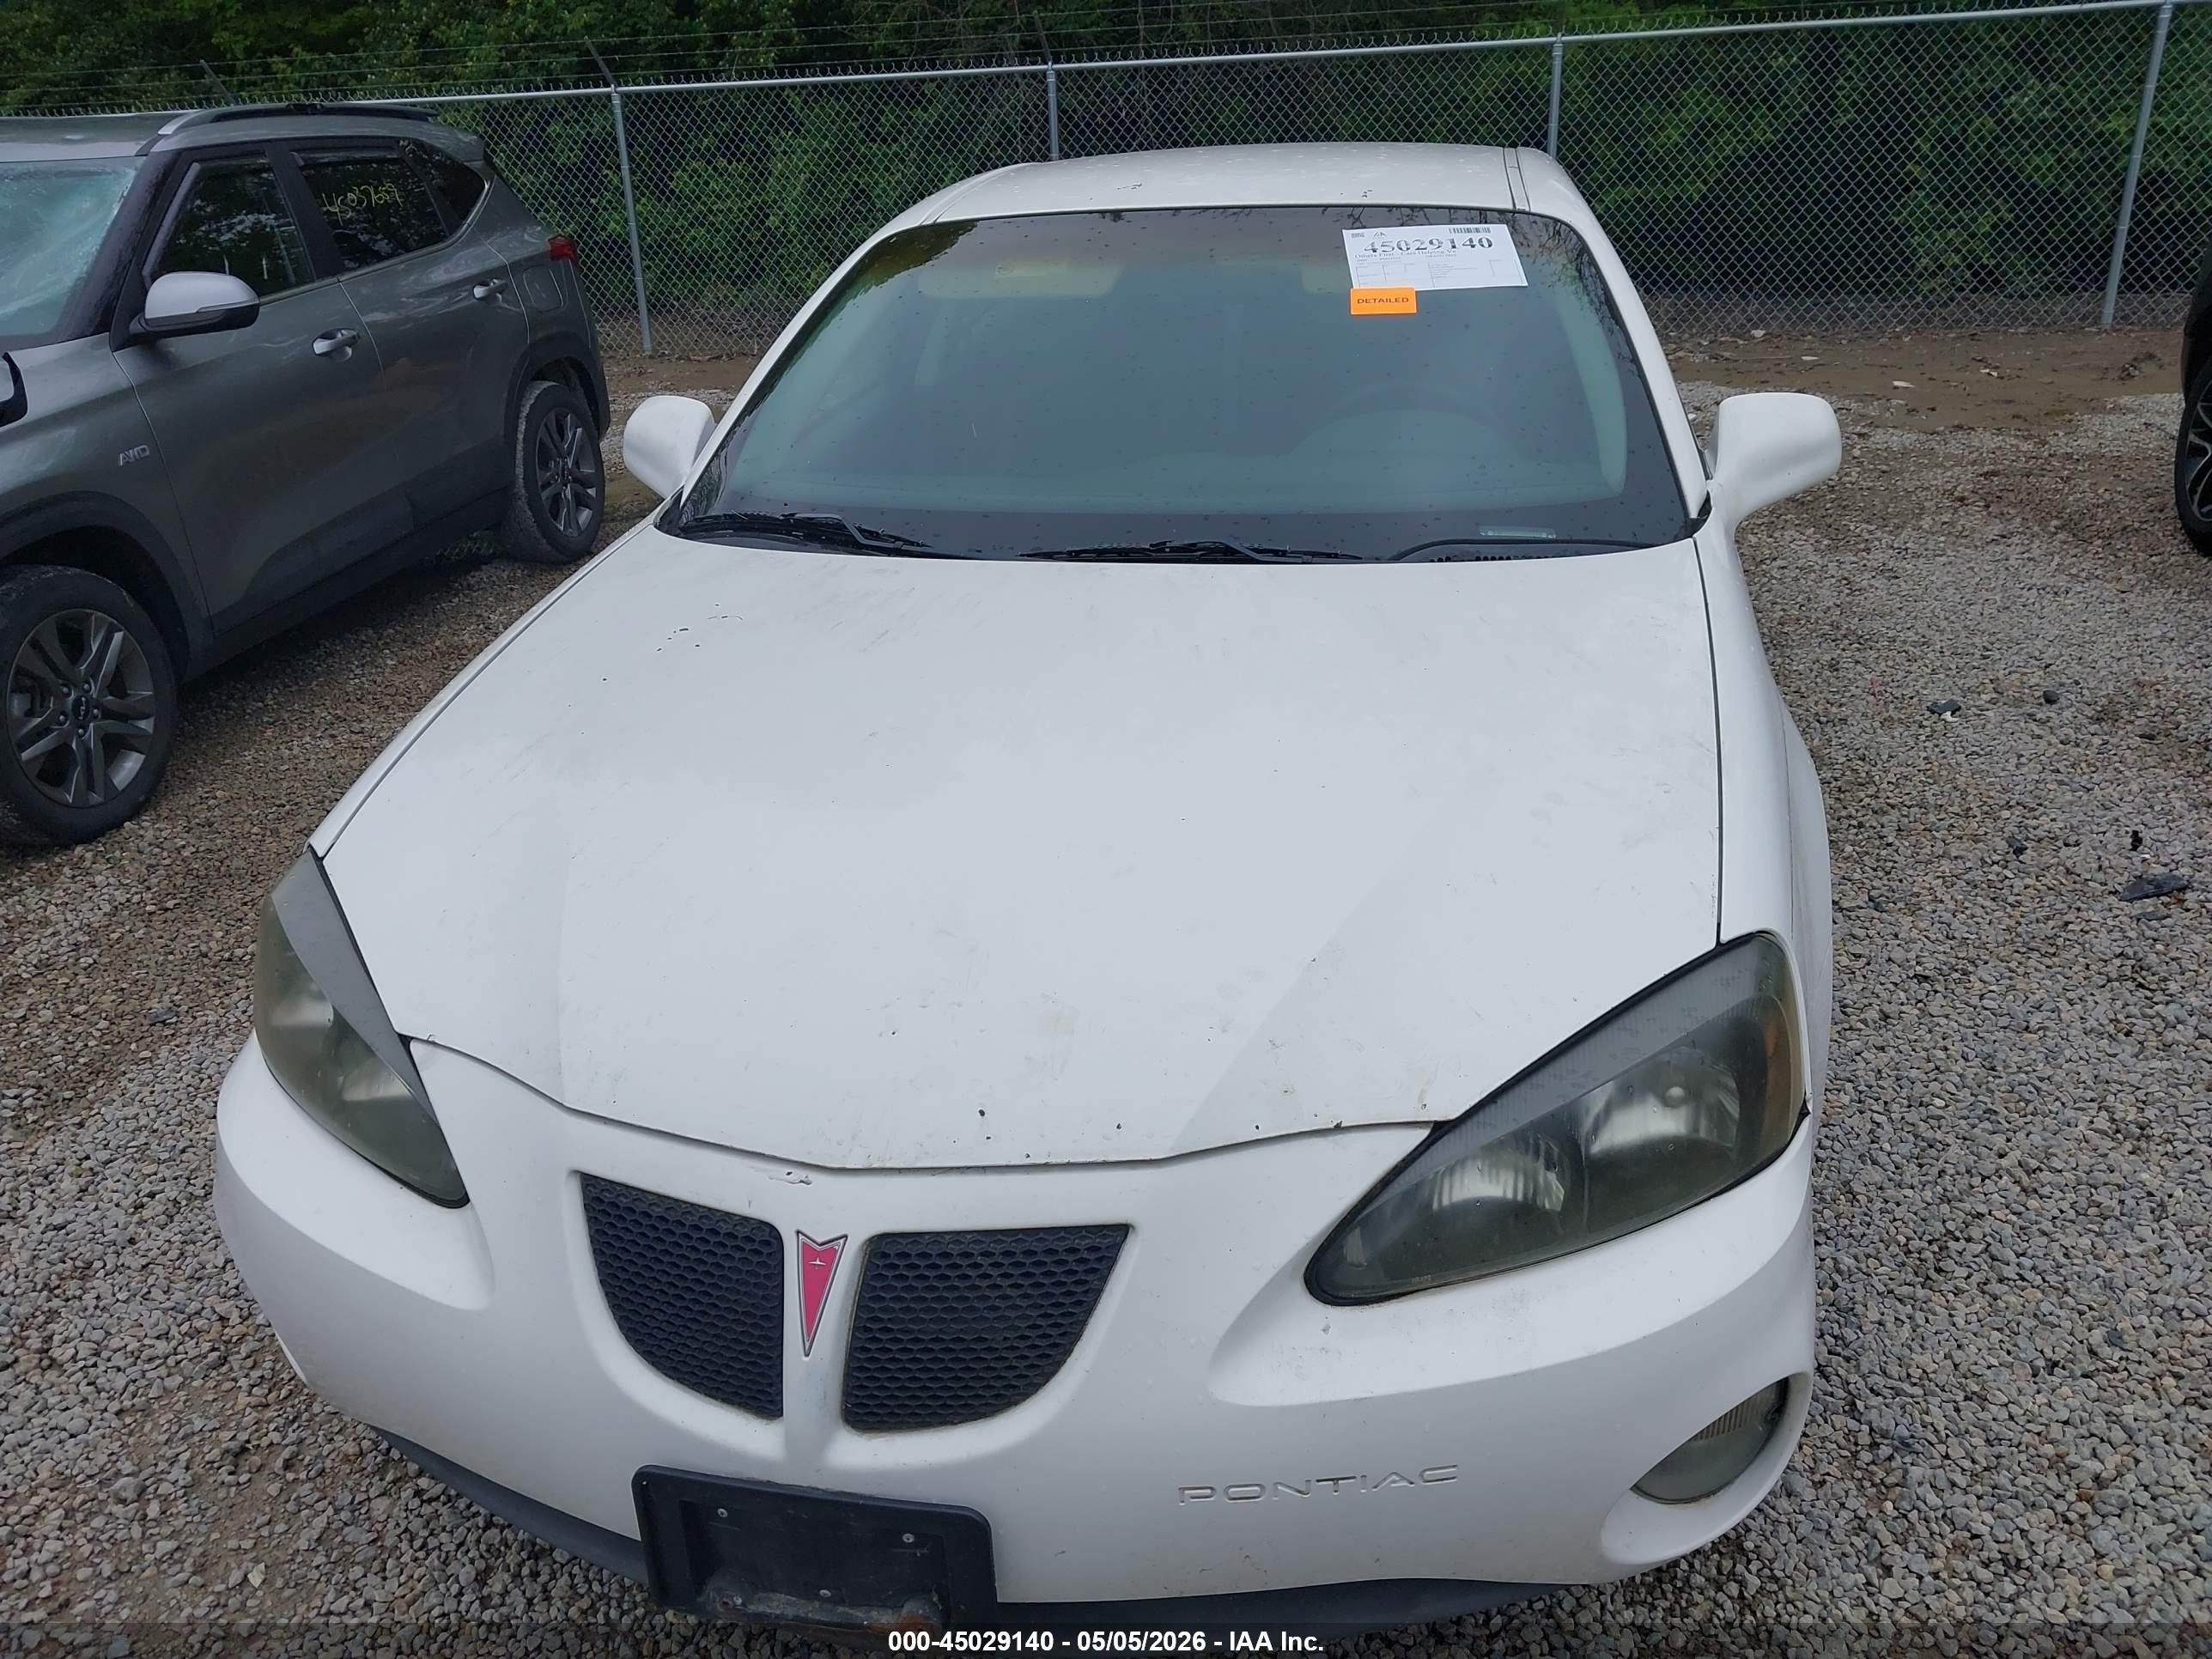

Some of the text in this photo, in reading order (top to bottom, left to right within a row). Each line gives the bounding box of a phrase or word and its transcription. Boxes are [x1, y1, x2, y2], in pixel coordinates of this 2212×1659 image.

[1364, 237, 1492, 253] 45029140
[119, 445, 150, 466] AWD
[1177, 1464, 1458, 1505] PONTIAC
